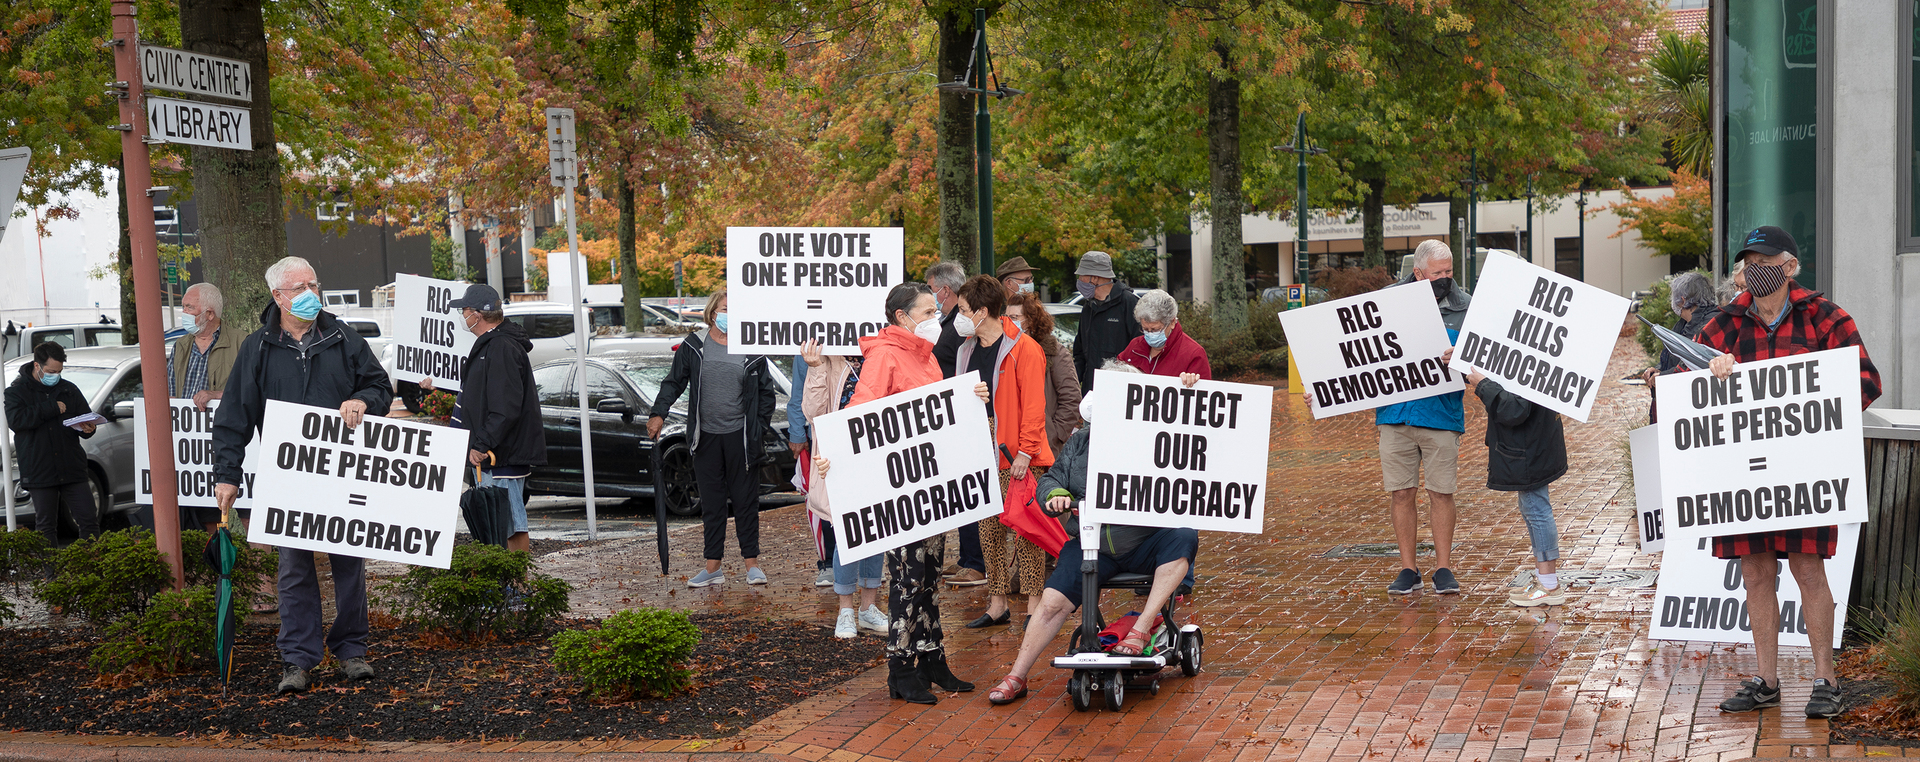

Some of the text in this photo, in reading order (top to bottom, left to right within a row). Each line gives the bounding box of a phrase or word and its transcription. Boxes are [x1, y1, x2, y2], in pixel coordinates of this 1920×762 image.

[145, 48, 242, 96] CIVIC CENTRE
[163, 104, 242, 143] LIBRARY
[1384, 210, 1437, 222] COUNCIL
[1392, 223, 1421, 231] Rotorua
[759, 232, 871, 258] ONE VOTE
[741, 262, 888, 288] ONE PERSON
[1527, 276, 1574, 318] RLC
[426, 285, 452, 315] RLC
[1336, 300, 1383, 335] RLC
[419, 316, 455, 348] KILLS
[1338, 331, 1404, 369] KILLS
[1506, 309, 1569, 357] KILLS
[396, 344, 468, 381] DEMOCRA
[1312, 356, 1453, 408] DEMOCRACY
[1459, 331, 1595, 409] DEMOCRACY
[1691, 359, 1821, 410] ONE VOTE
[170, 406, 214, 433] ROTE
[847, 388, 956, 455] PROTECT
[1125, 383, 1242, 429] PROTECT
[1674, 396, 1843, 451] ONE PERSON
[178, 438, 215, 466] OUR
[301, 412, 432, 457] ONE VOTE
[1153, 431, 1208, 471] OUR
[276, 442, 447, 492] ONE PERSON
[886, 442, 939, 489] OUR
[842, 468, 991, 549] DEMOCRACY
[1095, 472, 1258, 520] DEMOCRACY
[1676, 477, 1850, 528] DEMOCRACY
[264, 507, 442, 557] DEMOCRACY
